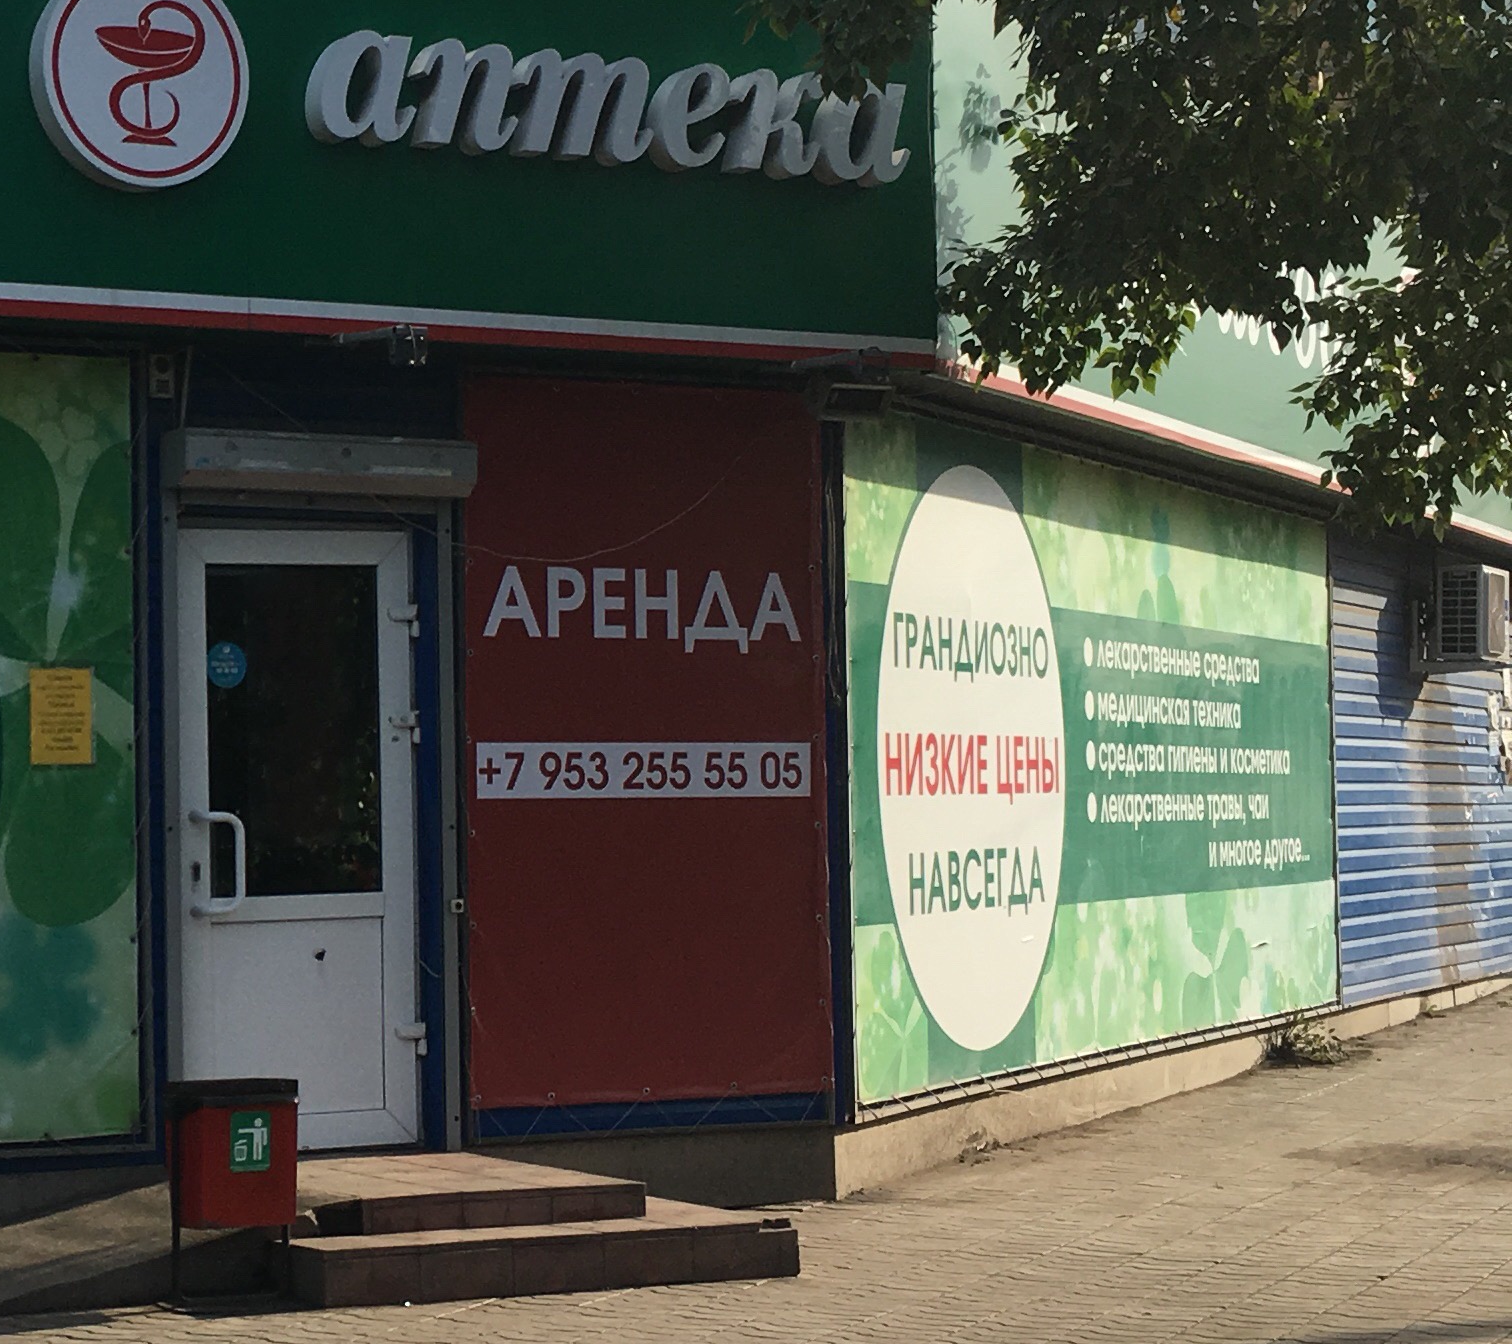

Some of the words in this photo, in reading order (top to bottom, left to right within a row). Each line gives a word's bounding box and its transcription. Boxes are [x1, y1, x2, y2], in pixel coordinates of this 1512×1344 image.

[304, 29, 910, 188] аптека
[483, 565, 802, 654] АРЕНДА
[893, 612, 1049, 683] ГРАНДИОЗНО
[1097, 640, 1201, 679] лекарственные
[1204, 652, 1260, 687] средства
[1098, 692, 1189, 728] медицинская
[1192, 699, 1241, 729] техника
[479, 751, 526, 791] +7
[539, 751, 609, 791] 953
[623, 751, 691, 791] 255
[705, 751, 748, 791] 55
[761, 751, 803, 791] 05
[885, 732, 988, 796] НИЗКИЕ
[996, 735, 1059, 805] ЦЕНЫ
[1098, 742, 1165, 780] средства
[1168, 745, 1218, 773] гигиены
[1220, 748, 1228, 773] и
[1231, 748, 1290, 775] косметика
[1101, 794, 1204, 831] лекарственные
[1207, 794, 1246, 828] травы,
[1209, 842, 1216, 867] и
[1219, 840, 1261, 867] многое
[908, 846, 1045, 917] НАВСЕГДА
